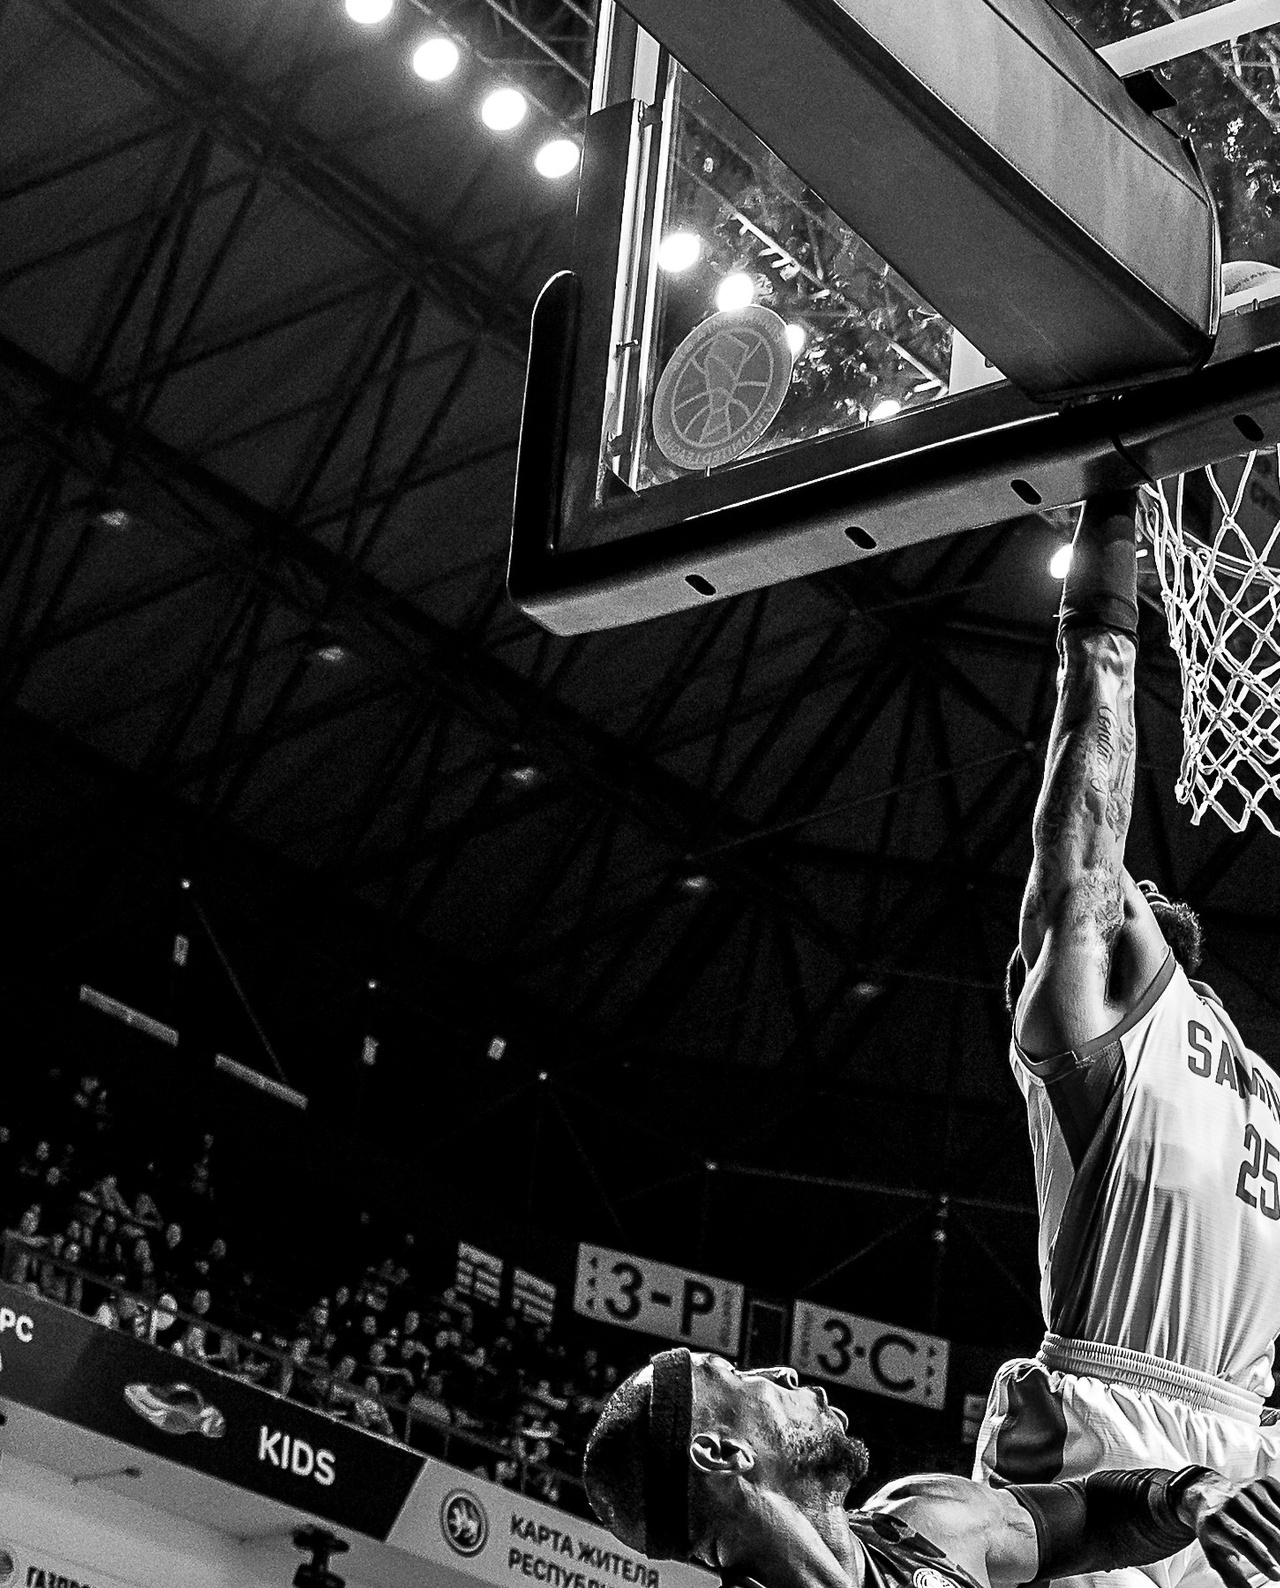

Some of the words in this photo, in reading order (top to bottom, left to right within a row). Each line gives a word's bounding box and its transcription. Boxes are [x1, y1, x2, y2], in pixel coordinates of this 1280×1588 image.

[1235, 1122, 1280, 1221] 25
[258, 1426, 337, 1487] KIDS
[509, 1511, 578, 1560] КАРТА
